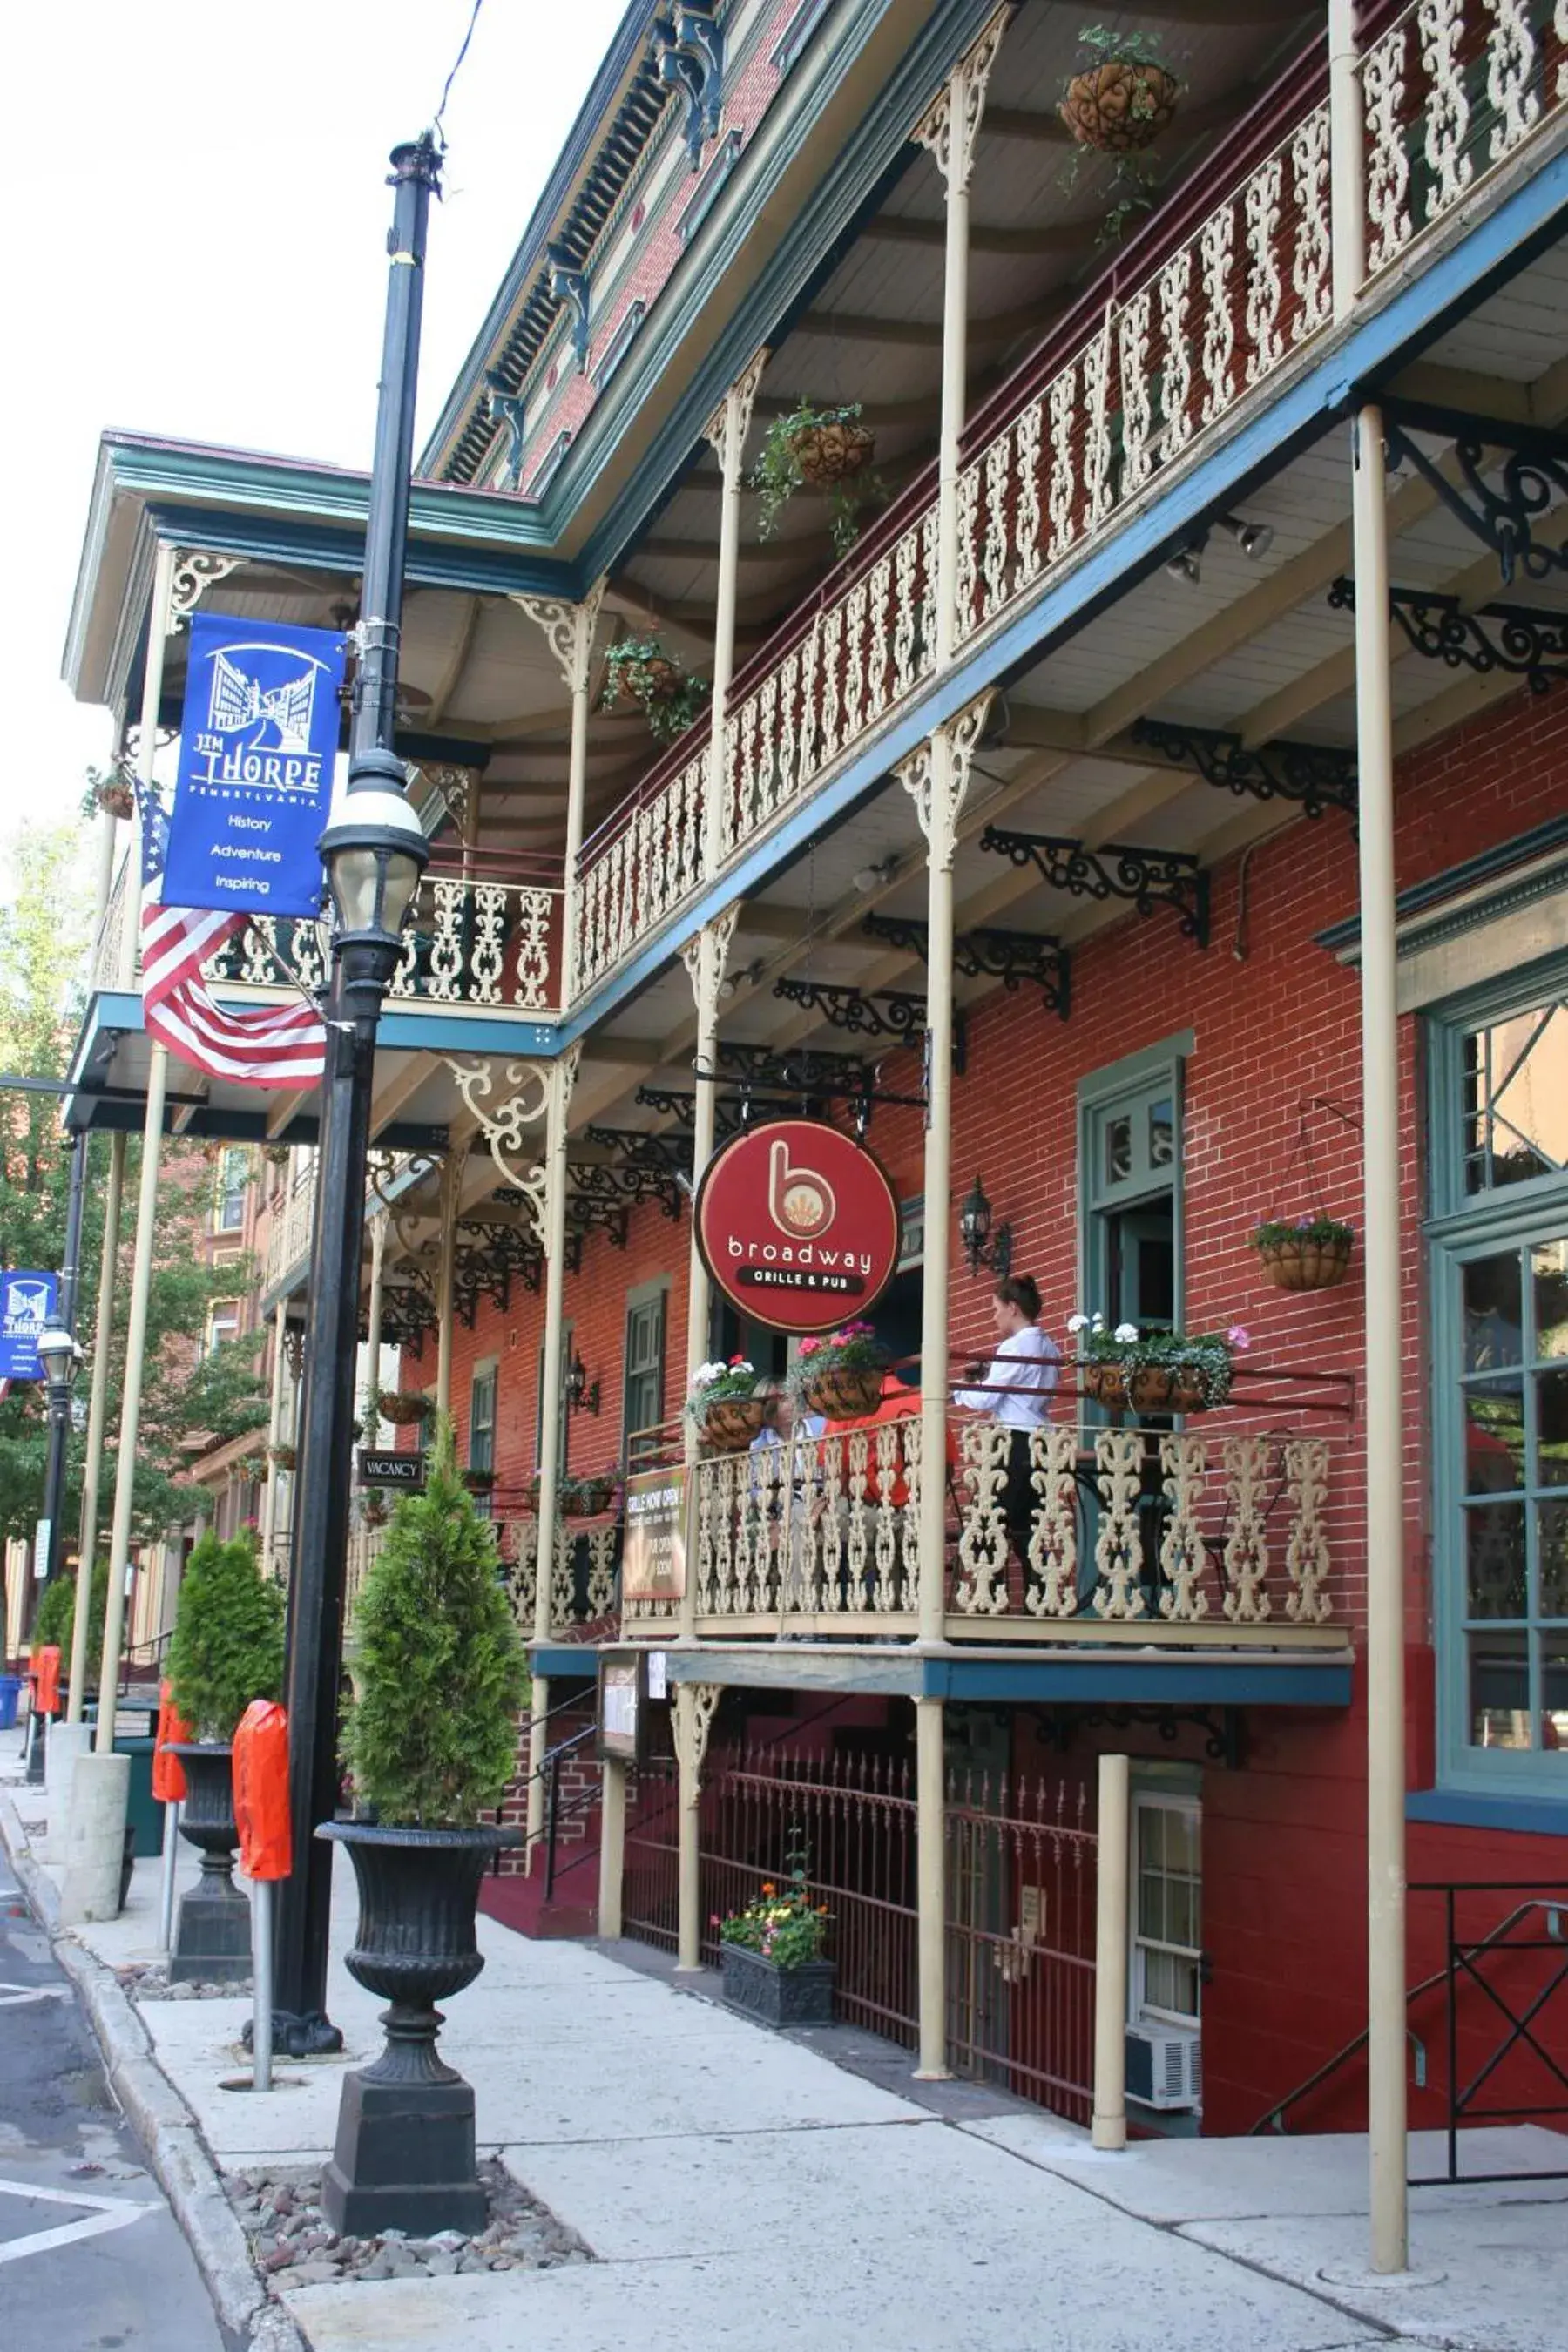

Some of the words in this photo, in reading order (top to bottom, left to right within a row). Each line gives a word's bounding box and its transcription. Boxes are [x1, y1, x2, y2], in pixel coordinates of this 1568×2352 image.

[193, 733, 224, 752] JIM
[199, 741, 322, 793] THORPE
[189, 785, 316, 808] PENNSYLVANIA
[228, 814, 272, 833] History
[210, 844, 282, 862] Adventure
[215, 875, 271, 896] Inspiring
[728, 1235, 872, 1274] broadway
[754, 1270, 802, 1285] GRILLE
[808, 1274, 816, 1285] &
[822, 1275, 848, 1288] PUB
[366, 1461, 417, 1477] VACANCY
[645, 1490, 662, 1511] NOW
